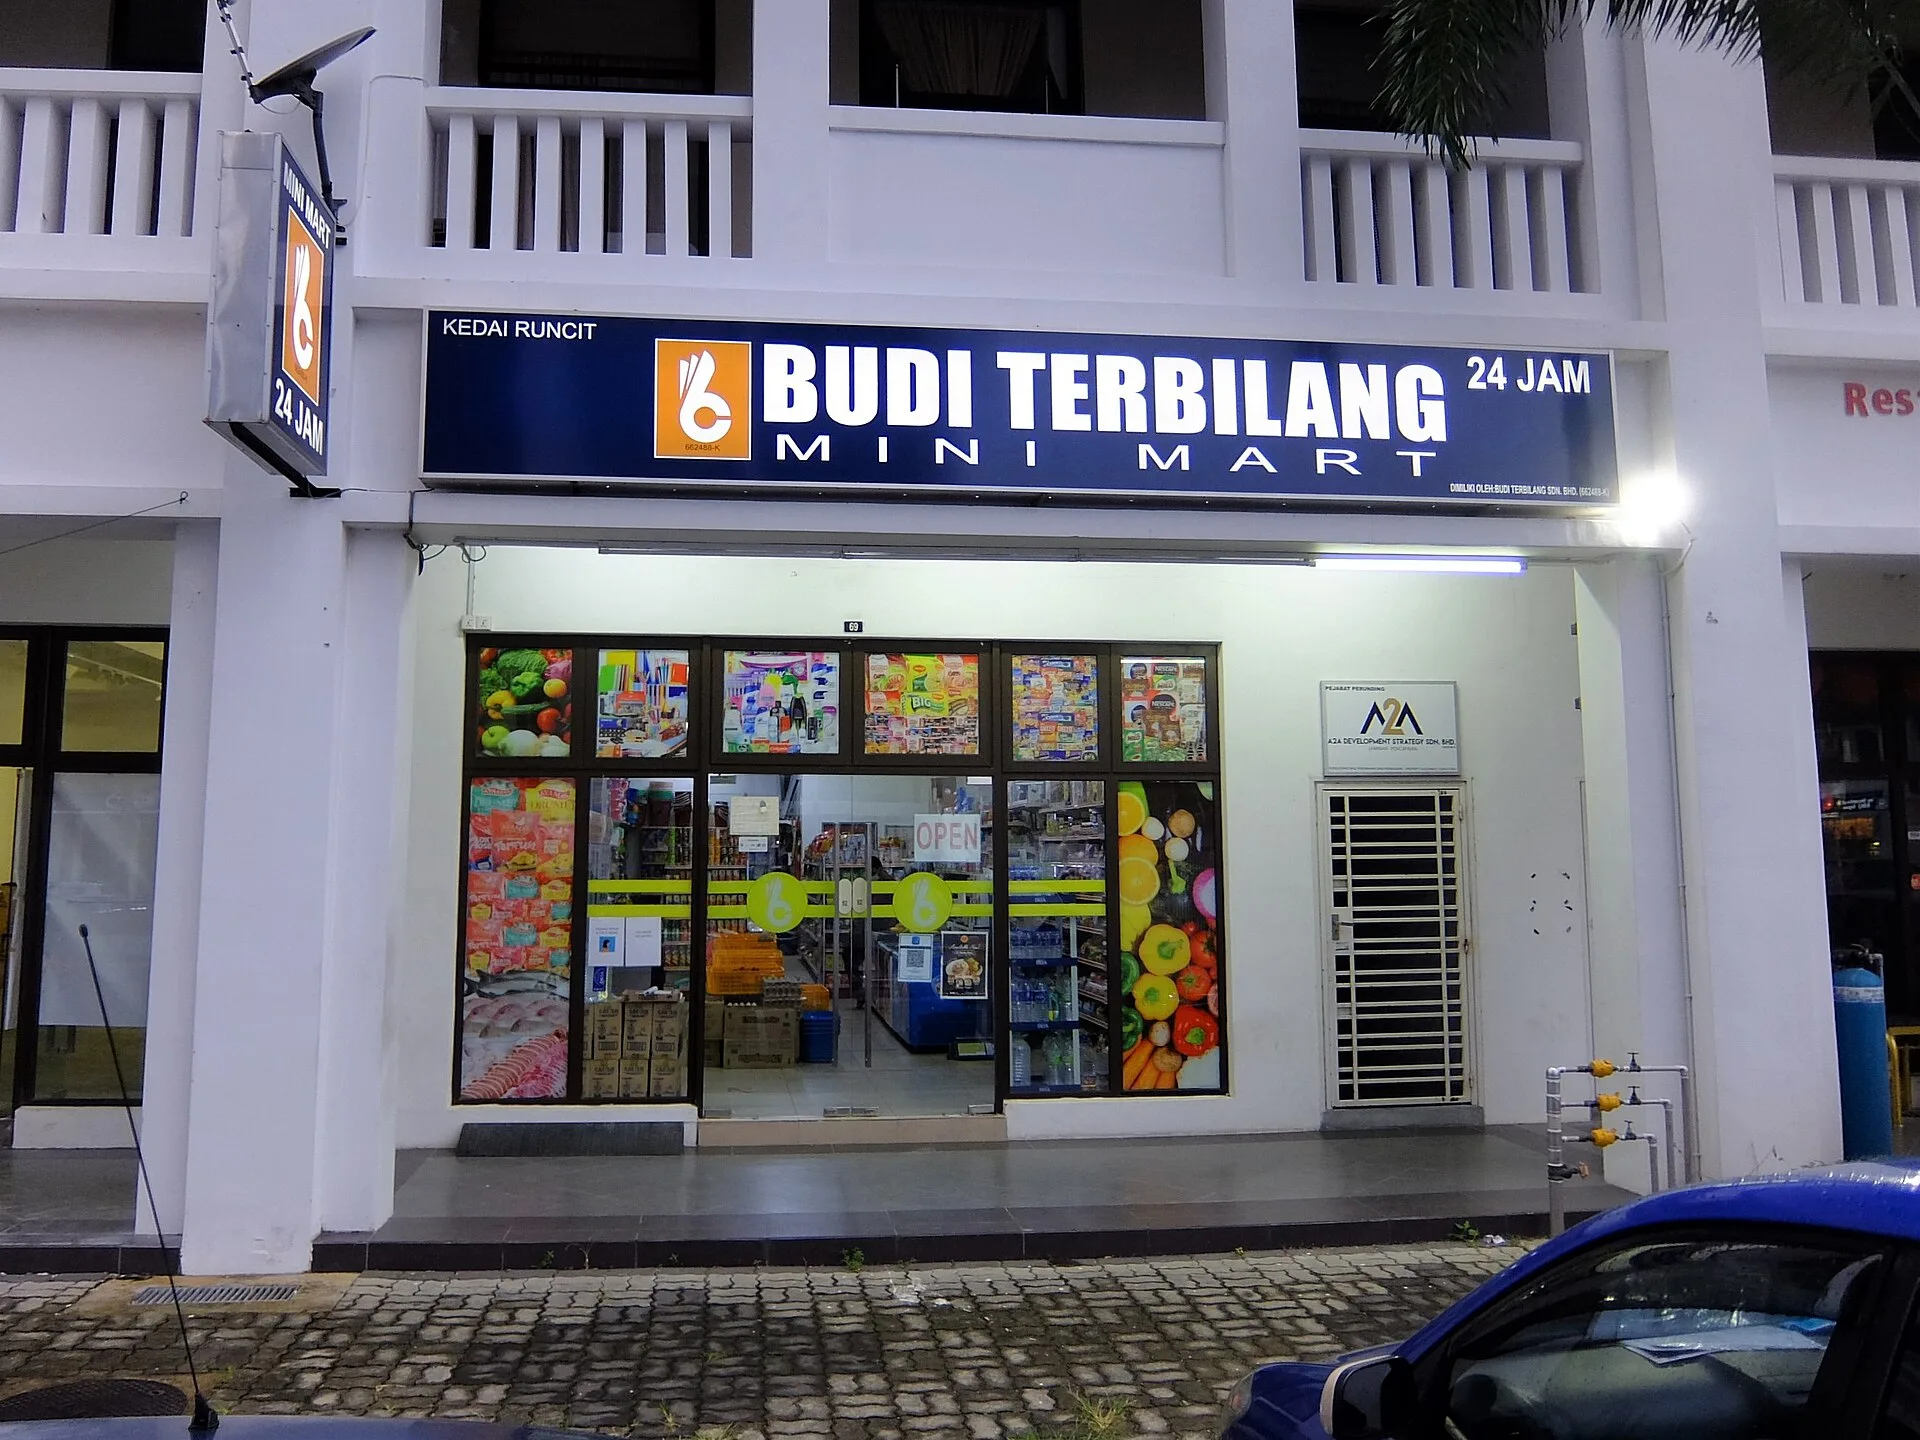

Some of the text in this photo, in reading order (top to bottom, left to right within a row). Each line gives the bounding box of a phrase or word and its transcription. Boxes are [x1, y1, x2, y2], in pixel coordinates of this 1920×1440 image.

[283, 161, 331, 249] MINI MART
[443, 318, 598, 340] KEDAI RUNCIT
[763, 342, 1448, 442] BUDI TERBILANG
[1466, 356, 1591, 394] 24 JAM
[274, 377, 293, 426] 24
[294, 399, 324, 456] JAM
[1842, 382, 1920, 418] Res
[776, 433, 1437, 477] MINI MART
[1450, 483, 1475, 493] DIMILIKI
[1511, 485, 1546, 495] TERBILANG
[849, 622, 859, 631] 69
[1360, 697, 1424, 735] A2A
[1343, 738, 1391, 746] DEVELOPMENT
[1392, 738, 1424, 746] STRATEGY
[916, 821, 978, 850] OPEN
